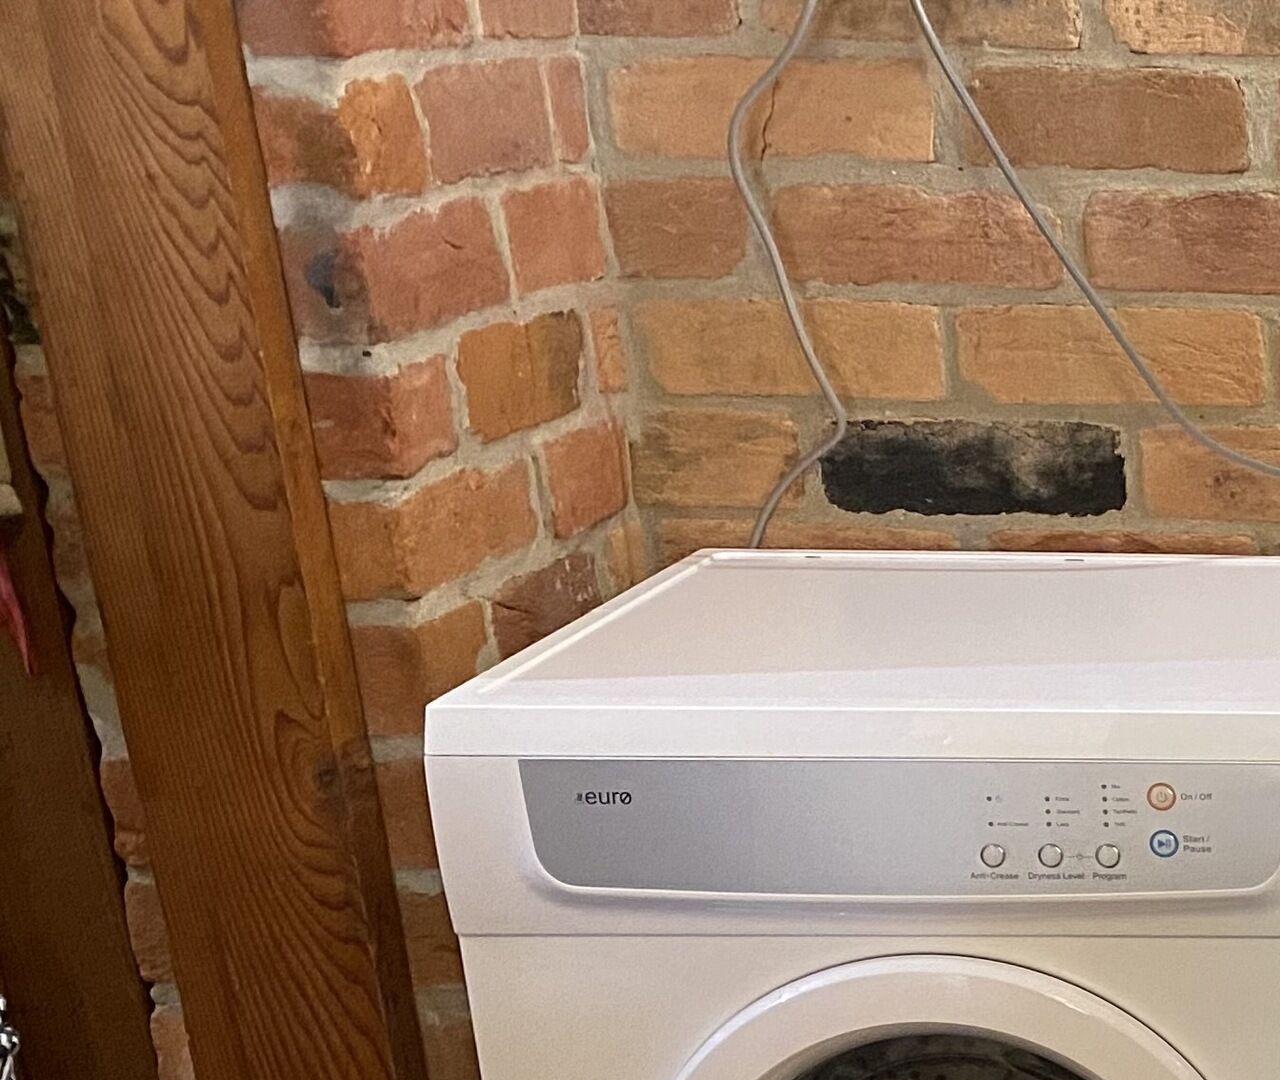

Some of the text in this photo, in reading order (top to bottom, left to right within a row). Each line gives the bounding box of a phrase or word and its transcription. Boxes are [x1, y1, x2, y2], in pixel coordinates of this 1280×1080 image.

[1183, 835, 1205, 843] Start
[1183, 845, 1212, 853] Pause
[970, 872, 1019, 880] Anti-Crease
[1028, 872, 1085, 881] Dryness Level
[1093, 872, 1127, 881] Program
